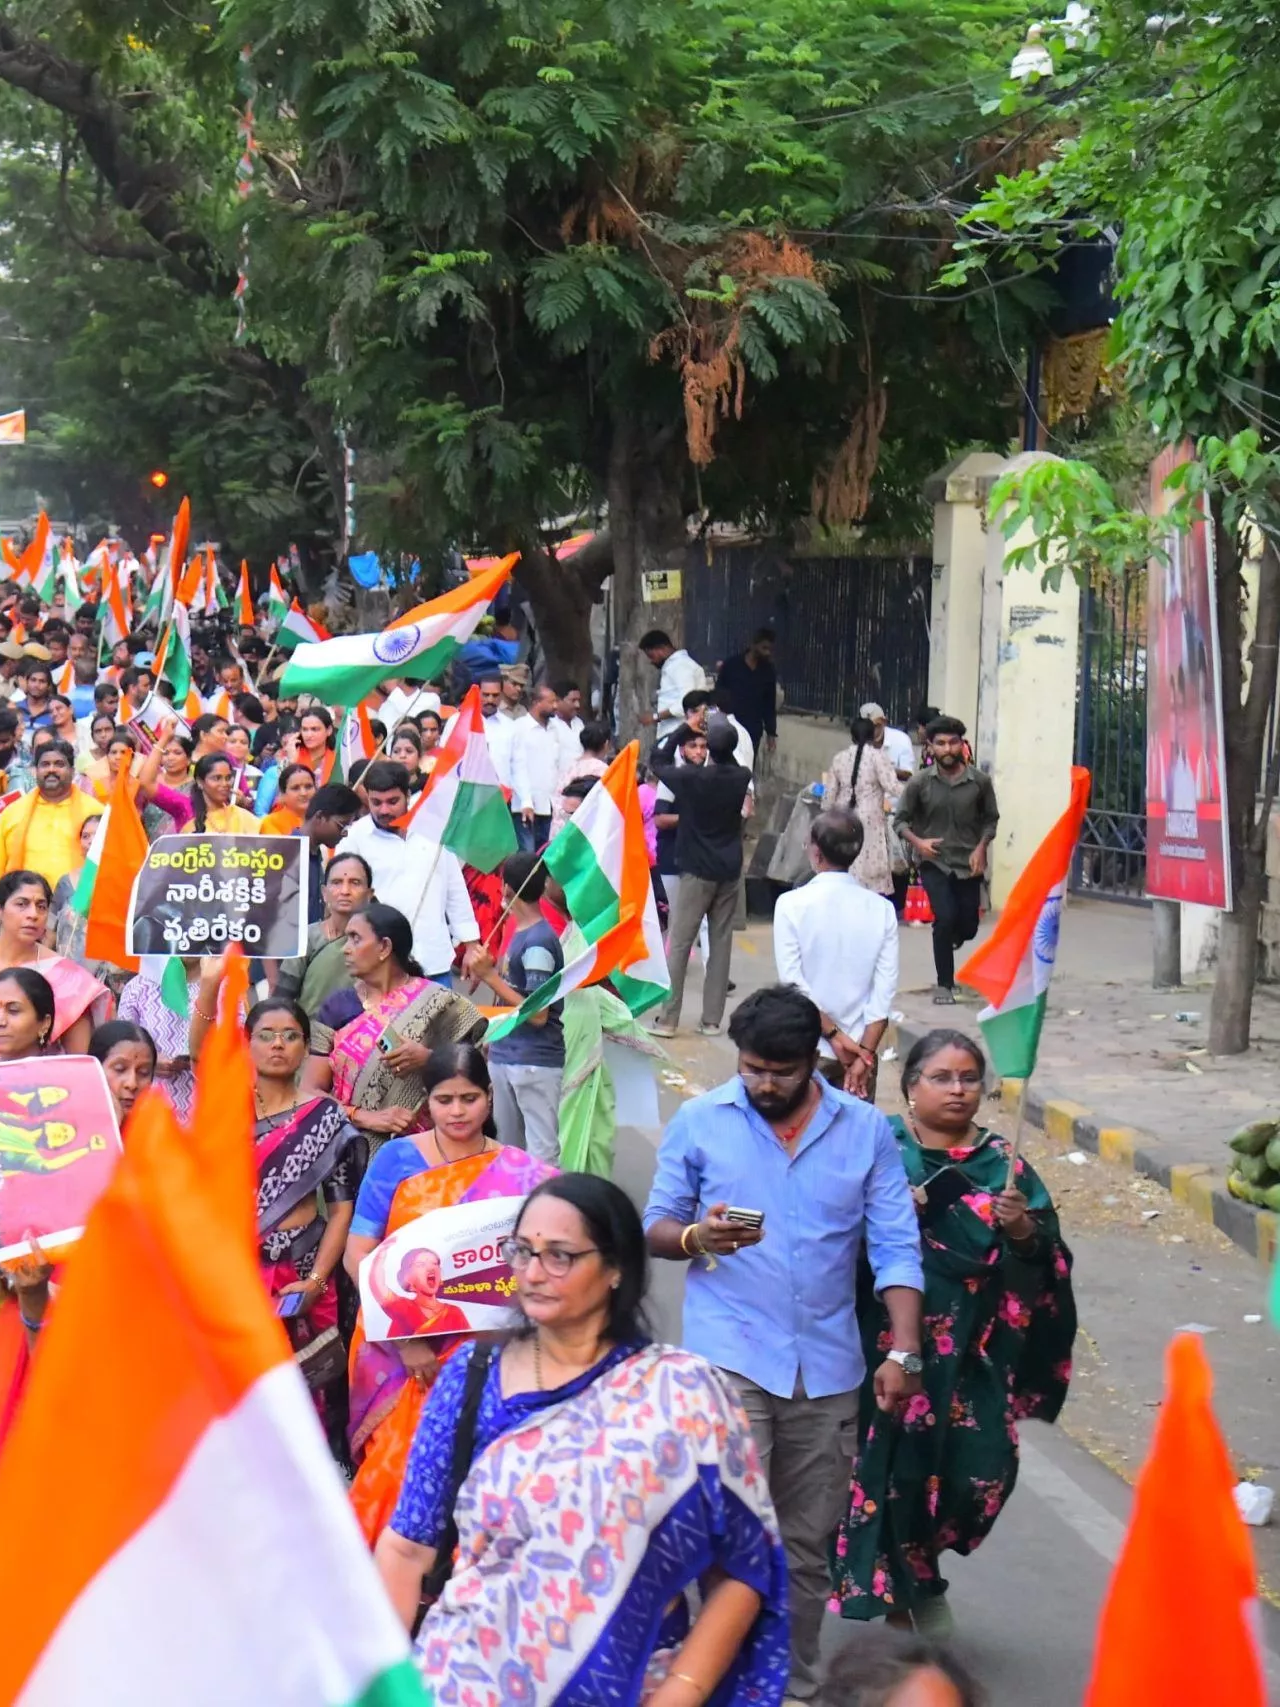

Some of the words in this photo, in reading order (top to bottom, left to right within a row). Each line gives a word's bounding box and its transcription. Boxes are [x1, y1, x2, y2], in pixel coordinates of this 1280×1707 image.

[149, 843, 216, 874] కాంగ్రెస్
[222, 846, 283, 877] హస్తం
[166, 873, 267, 912] నారీశక్తికి
[162, 914, 262, 951] వ్యతిరేకం
[451, 1235, 508, 1269] కాం
[443, 1282, 492, 1295] మహిళా
